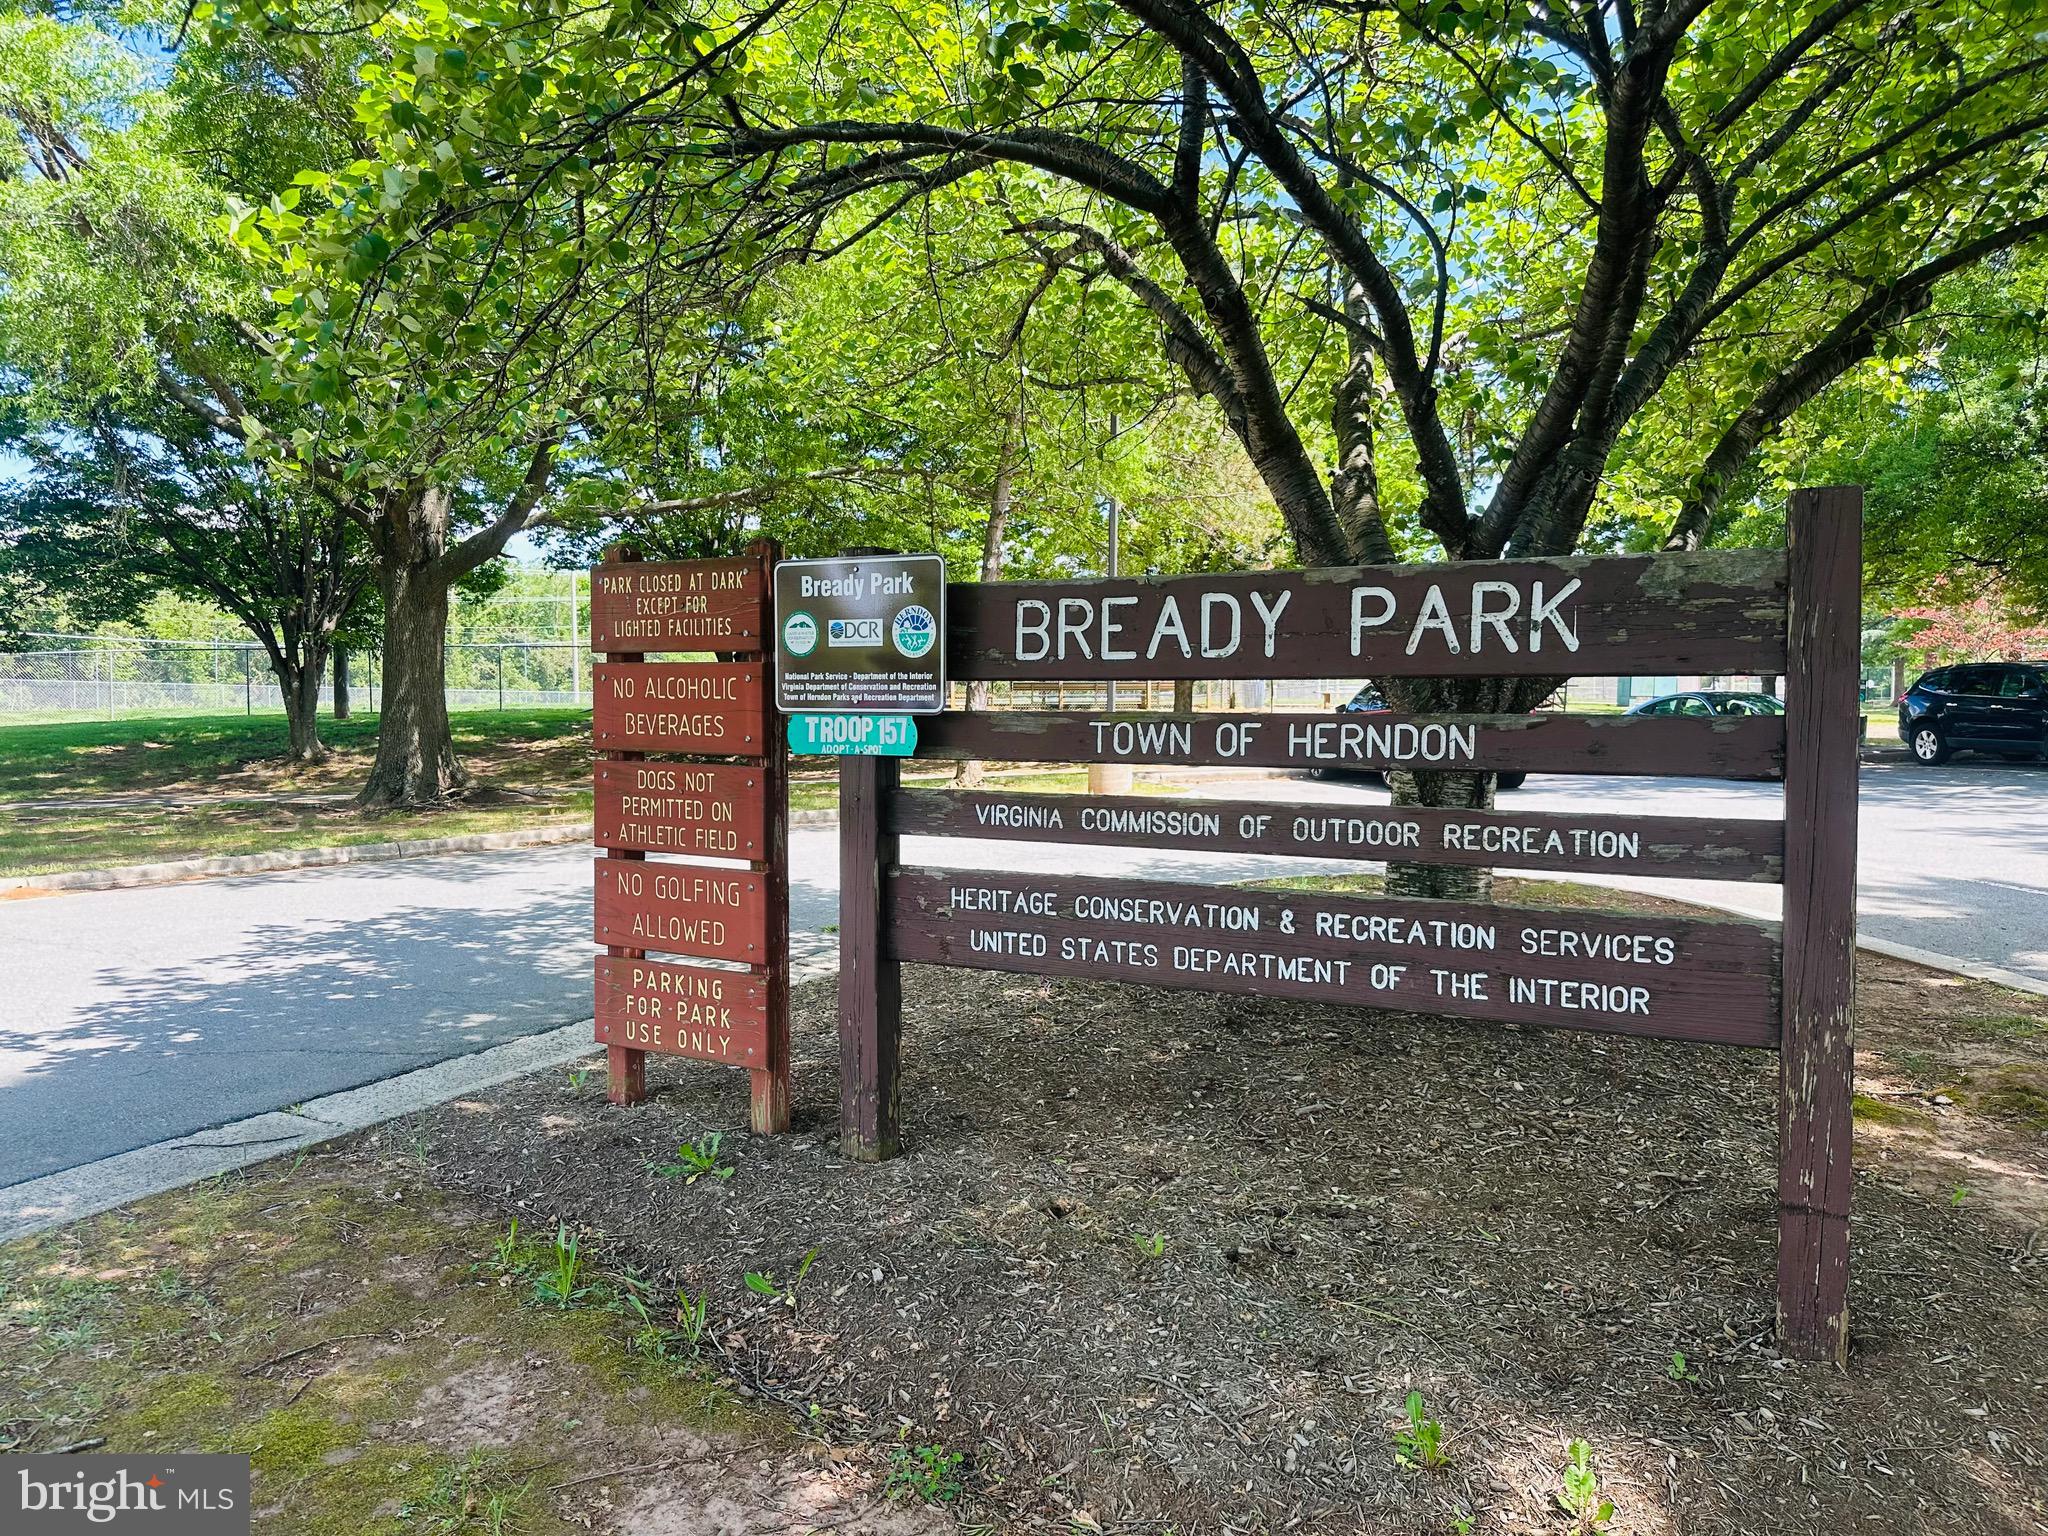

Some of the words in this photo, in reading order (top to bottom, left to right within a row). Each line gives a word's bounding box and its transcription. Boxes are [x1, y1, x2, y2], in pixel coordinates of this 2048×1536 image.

[603, 576, 632, 594] PARK
[639, 573, 681, 593] CLOSED
[689, 573, 703, 591] AT
[711, 571, 743, 590] DARK
[801, 574, 864, 600] Bready
[870, 571, 914, 595] Park
[637, 596, 677, 615] EXCEPT
[685, 595, 707, 614] FOR
[894, 607, 934, 625] HERNDON
[1015, 589, 1291, 661] BREADY
[1350, 577, 1581, 658] PARK
[614, 619, 661, 638] LIGHTED
[669, 618, 732, 637] FACILITIES
[844, 621, 880, 639] DCR
[614, 677, 635, 699] NO
[645, 677, 737, 700] ALCOHOLIC
[782, 683, 804, 692] Virginia
[805, 683, 840, 692] Department
[841, 683, 847, 691] of
[848, 682, 888, 691] Conservation
[889, 683, 901, 691] and
[902, 683, 937, 691] Recreation
[785, 672, 809, 680] National
[811, 672, 824, 680] Park
[825, 672, 848, 680] Service
[853, 672, 888, 682] Department
[889, 672, 896, 680] of
[897, 672, 908, 680] the
[909, 672, 933, 680] Interior
[784, 693, 798, 701] Town
[800, 693, 806, 701] of
[807, 693, 831, 701] Herndon
[833, 693, 850, 701] Parks
[851, 693, 862, 702] and
[864, 693, 896, 701] Recreation
[899, 693, 935, 703] Department
[625, 712, 724, 737] BEVERAGES
[805, 716, 873, 743] TROOP
[877, 717, 908, 744] 157
[1089, 720, 1191, 757] TOWN
[1215, 722, 1262, 759] OF
[1288, 721, 1476, 762] HERNDON
[637, 769, 676, 791] DOGS
[685, 772, 715, 793] NOT
[622, 796, 703, 820] PERMITTED
[711, 802, 733, 822] ON
[618, 823, 686, 847] ATHLETIC
[695, 828, 737, 851] FIELD
[975, 803, 1064, 829] VIRGINIA
[1081, 807, 1220, 837] COMMISSION
[1239, 814, 1272, 840] OF
[1292, 817, 1420, 847] OUTDOOR
[1444, 822, 1639, 859] RECREATION
[617, 871, 643, 897] NO
[655, 875, 740, 907] GOLFING
[632, 912, 725, 946] ALLOWED
[950, 887, 1058, 917] HERITAGE
[1074, 895, 1260, 932] CONSERVATION
[1279, 908, 1296, 935] &
[1316, 911, 1495, 951] RECREATION
[1520, 927, 1675, 965] SERVICES
[633, 968, 723, 1000] PARKING
[969, 929, 1047, 957] UNITED
[1061, 937, 1158, 967] STATES
[1173, 946, 1352, 986] DEPARTMENT
[1371, 963, 1407, 991] OF
[1430, 969, 1489, 1001] THE
[1509, 976, 1650, 1015] INTERIOR
[626, 995, 662, 1019] FOR
[677, 1001, 731, 1030] PARK
[626, 1021, 662, 1045] USE
[677, 1029, 731, 1055] ONLY
